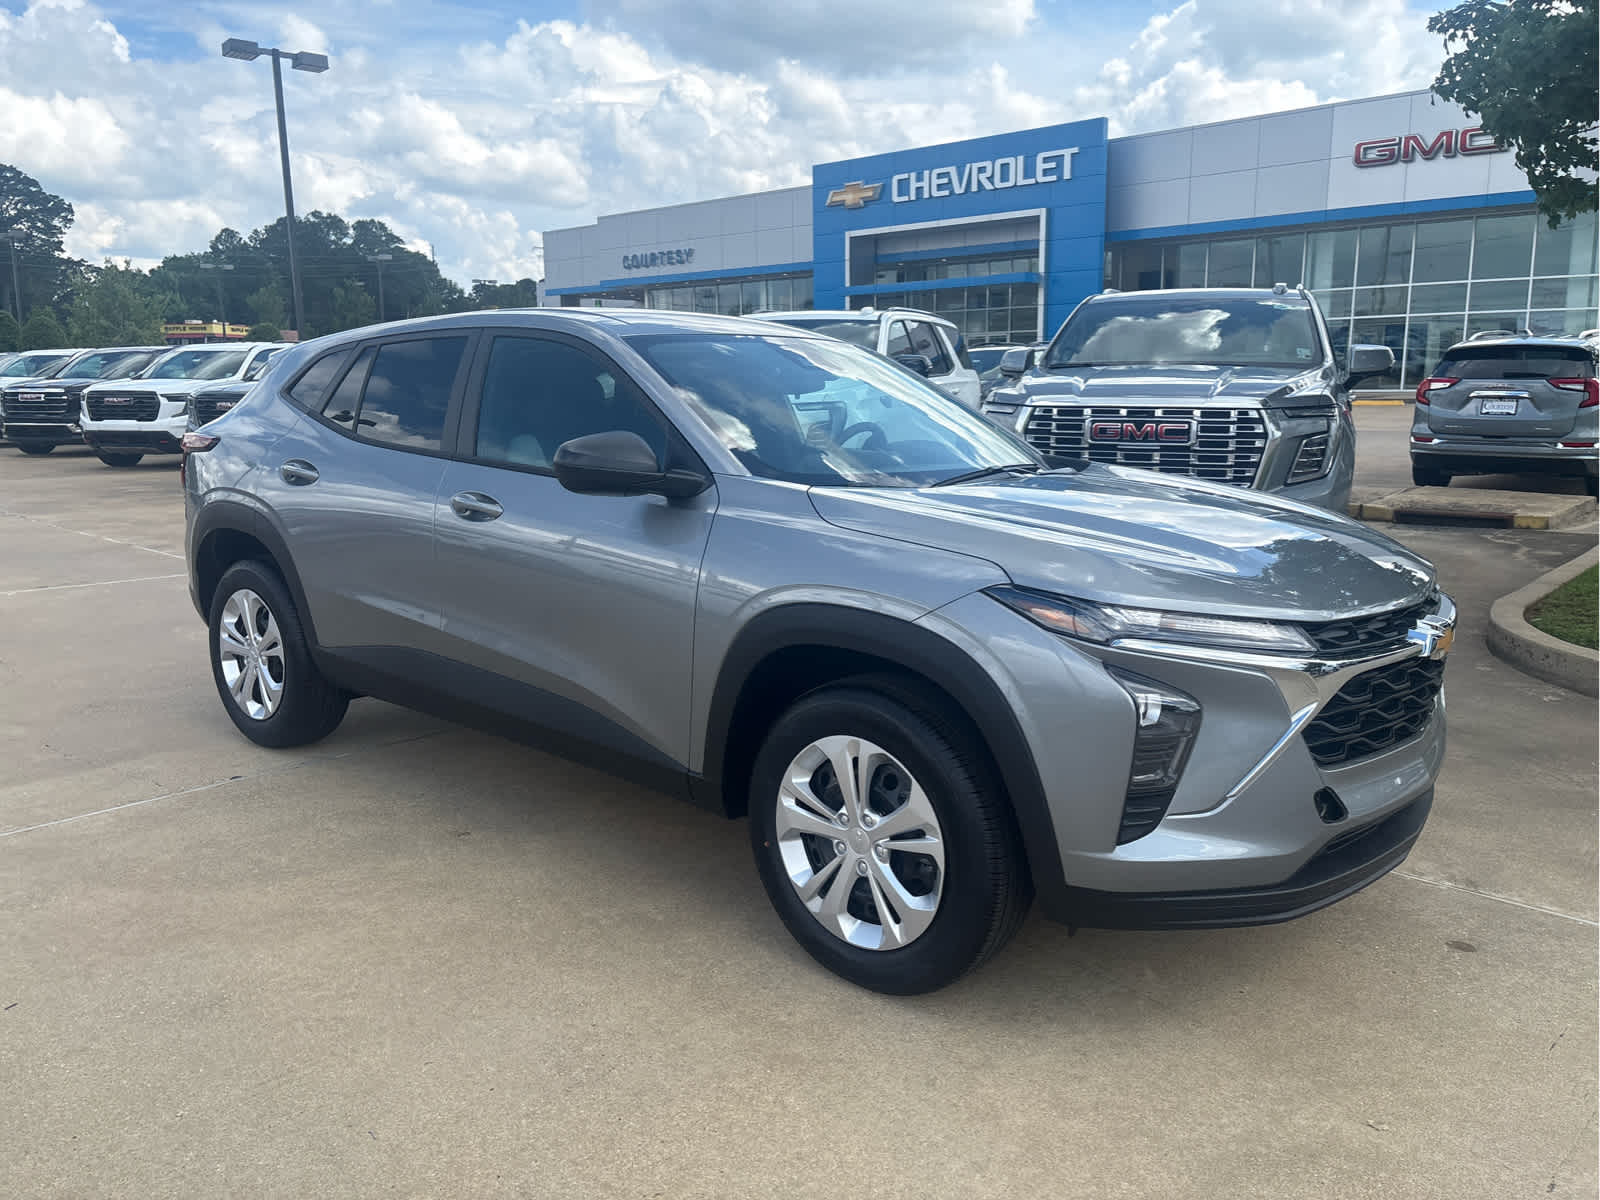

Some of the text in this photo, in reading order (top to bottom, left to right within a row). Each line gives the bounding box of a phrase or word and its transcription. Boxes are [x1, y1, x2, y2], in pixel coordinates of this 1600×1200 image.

[1352, 126, 1506, 168] GMC
[891, 146, 1080, 203] CHEVROLET
[622, 247, 696, 270] COURTESY
[1092, 422, 1189, 441] GMC
